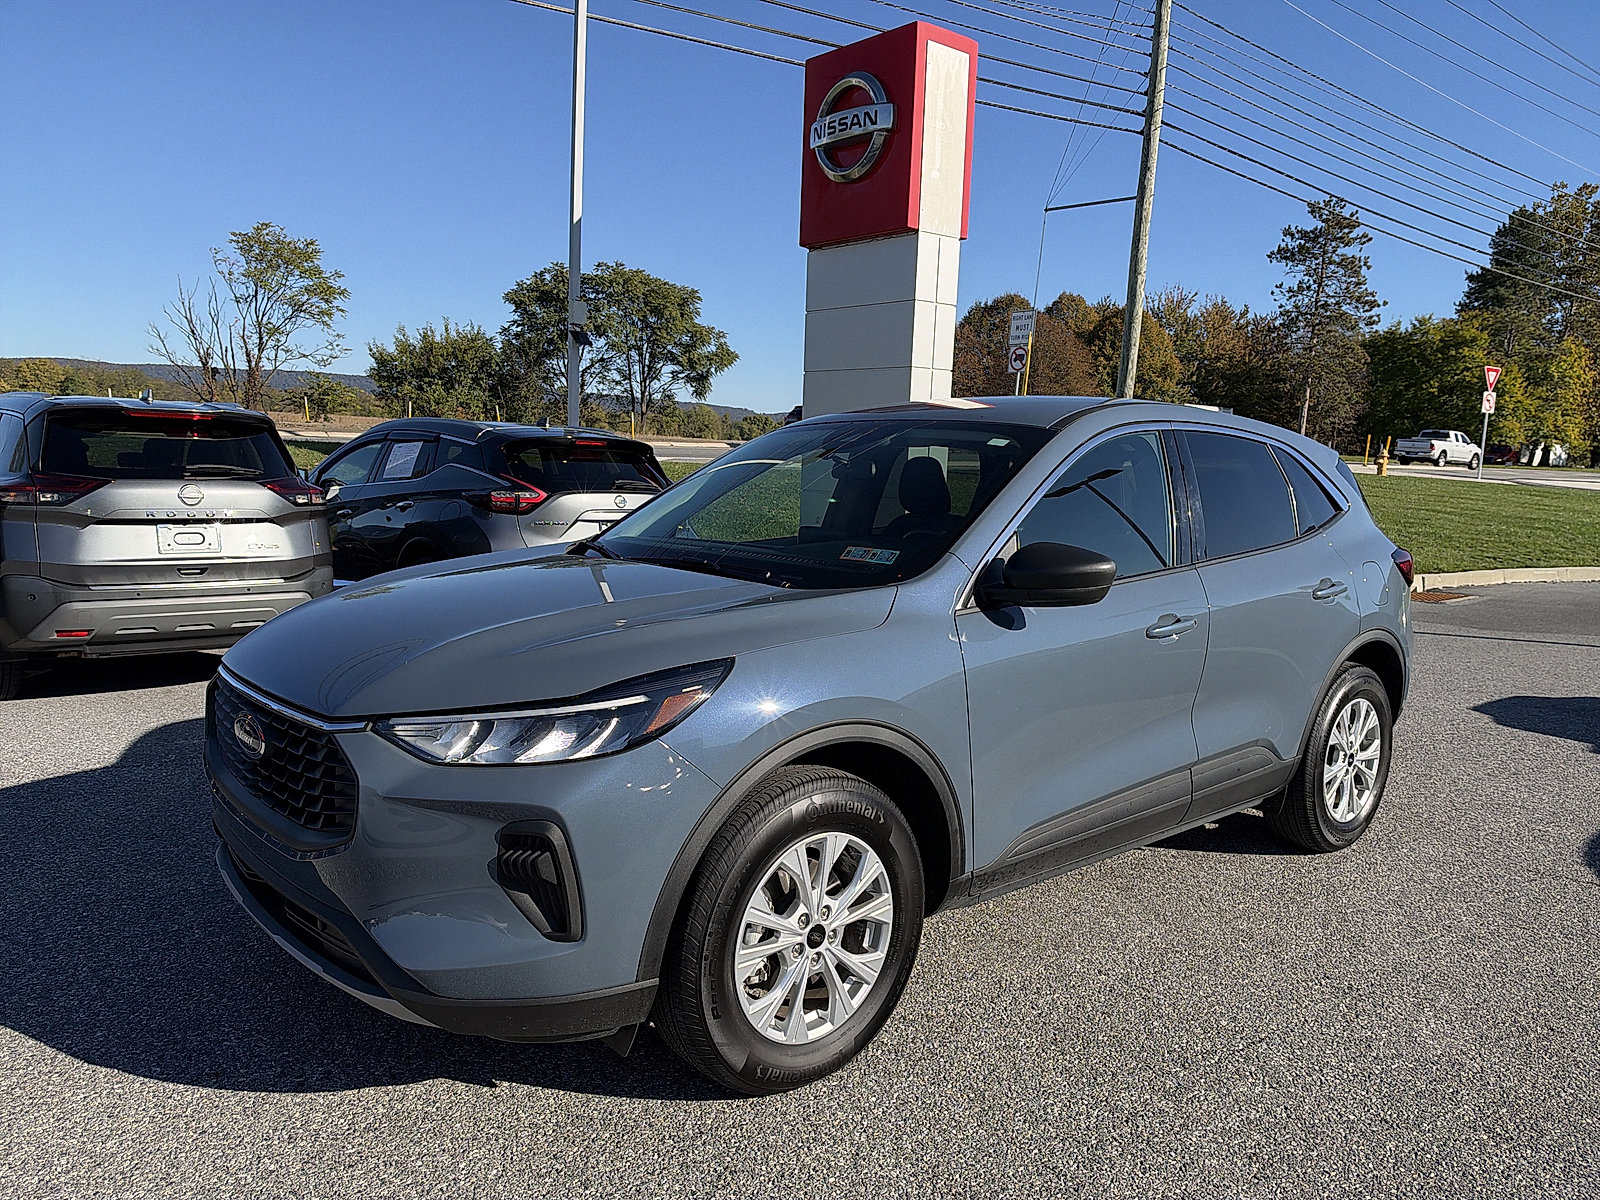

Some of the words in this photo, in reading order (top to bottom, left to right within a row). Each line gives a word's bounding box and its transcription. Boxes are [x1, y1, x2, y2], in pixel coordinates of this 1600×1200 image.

[813, 109, 878, 143] NISSAN
[1015, 323, 1030, 331] MUST
[804, 796, 877, 823] Continental
